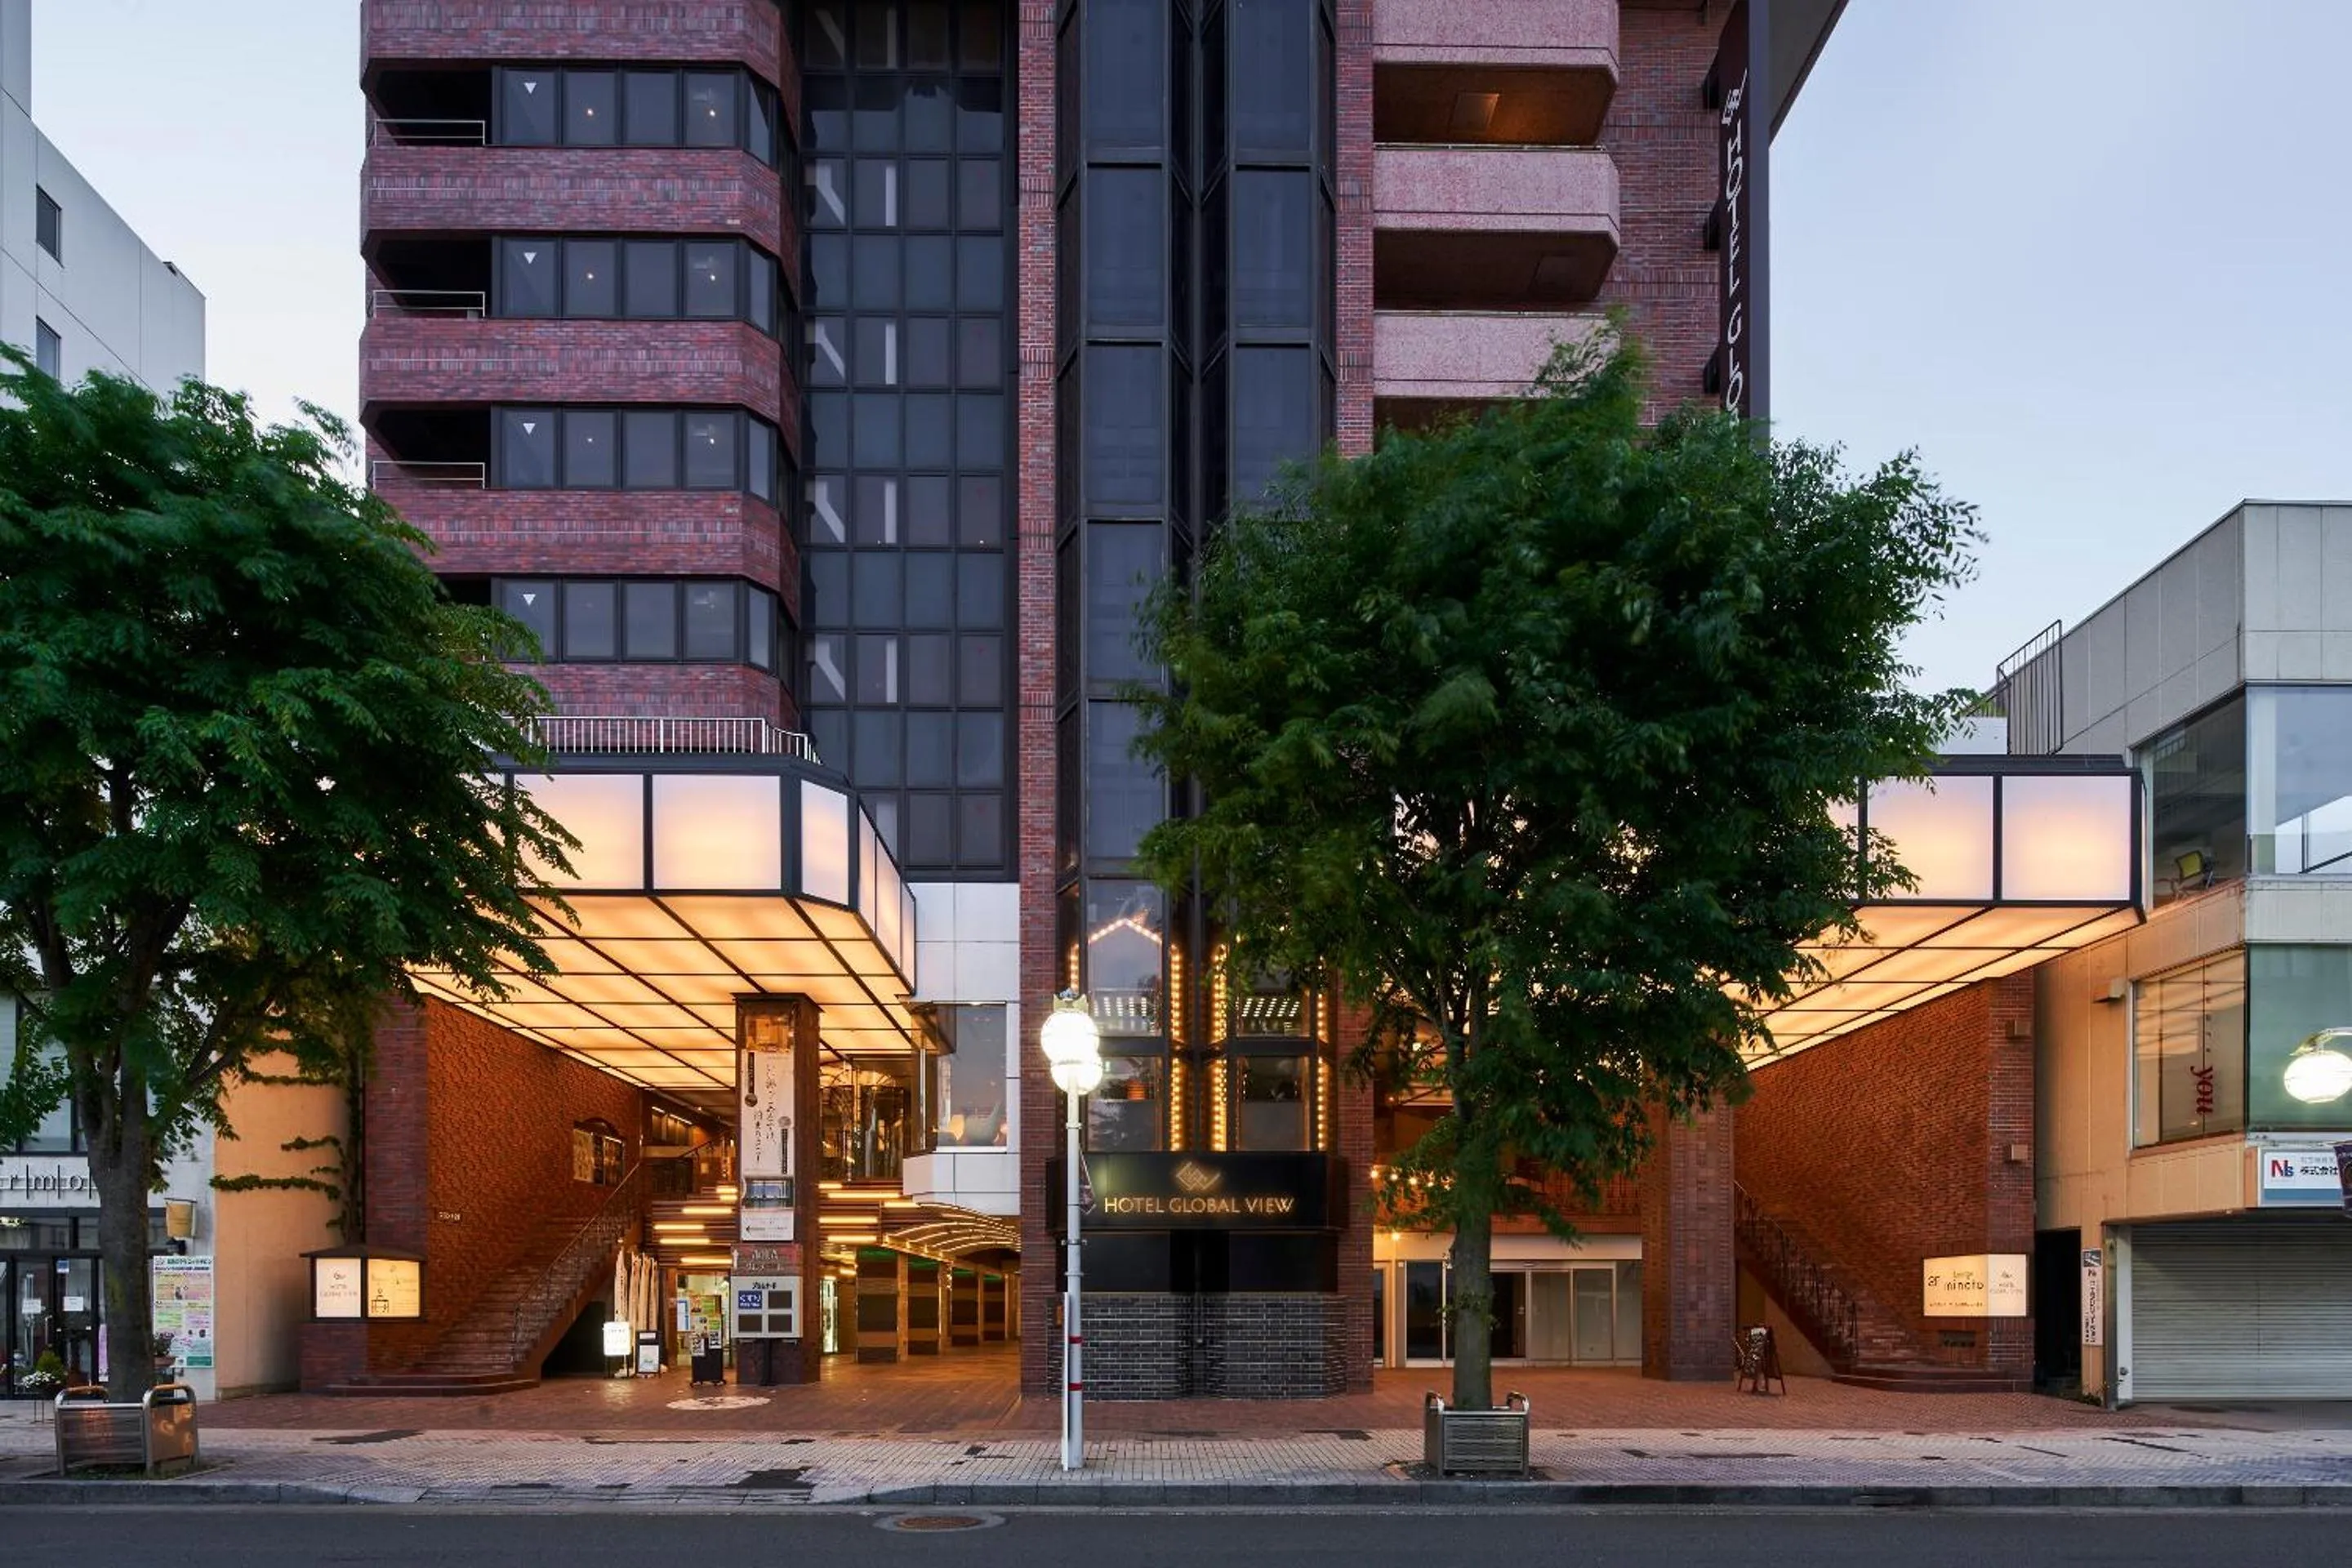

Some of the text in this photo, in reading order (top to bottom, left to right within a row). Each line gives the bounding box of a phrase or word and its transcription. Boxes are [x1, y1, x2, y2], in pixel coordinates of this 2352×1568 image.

[1104, 1197, 1294, 1213] HOTEL GLOBAL VIEW
